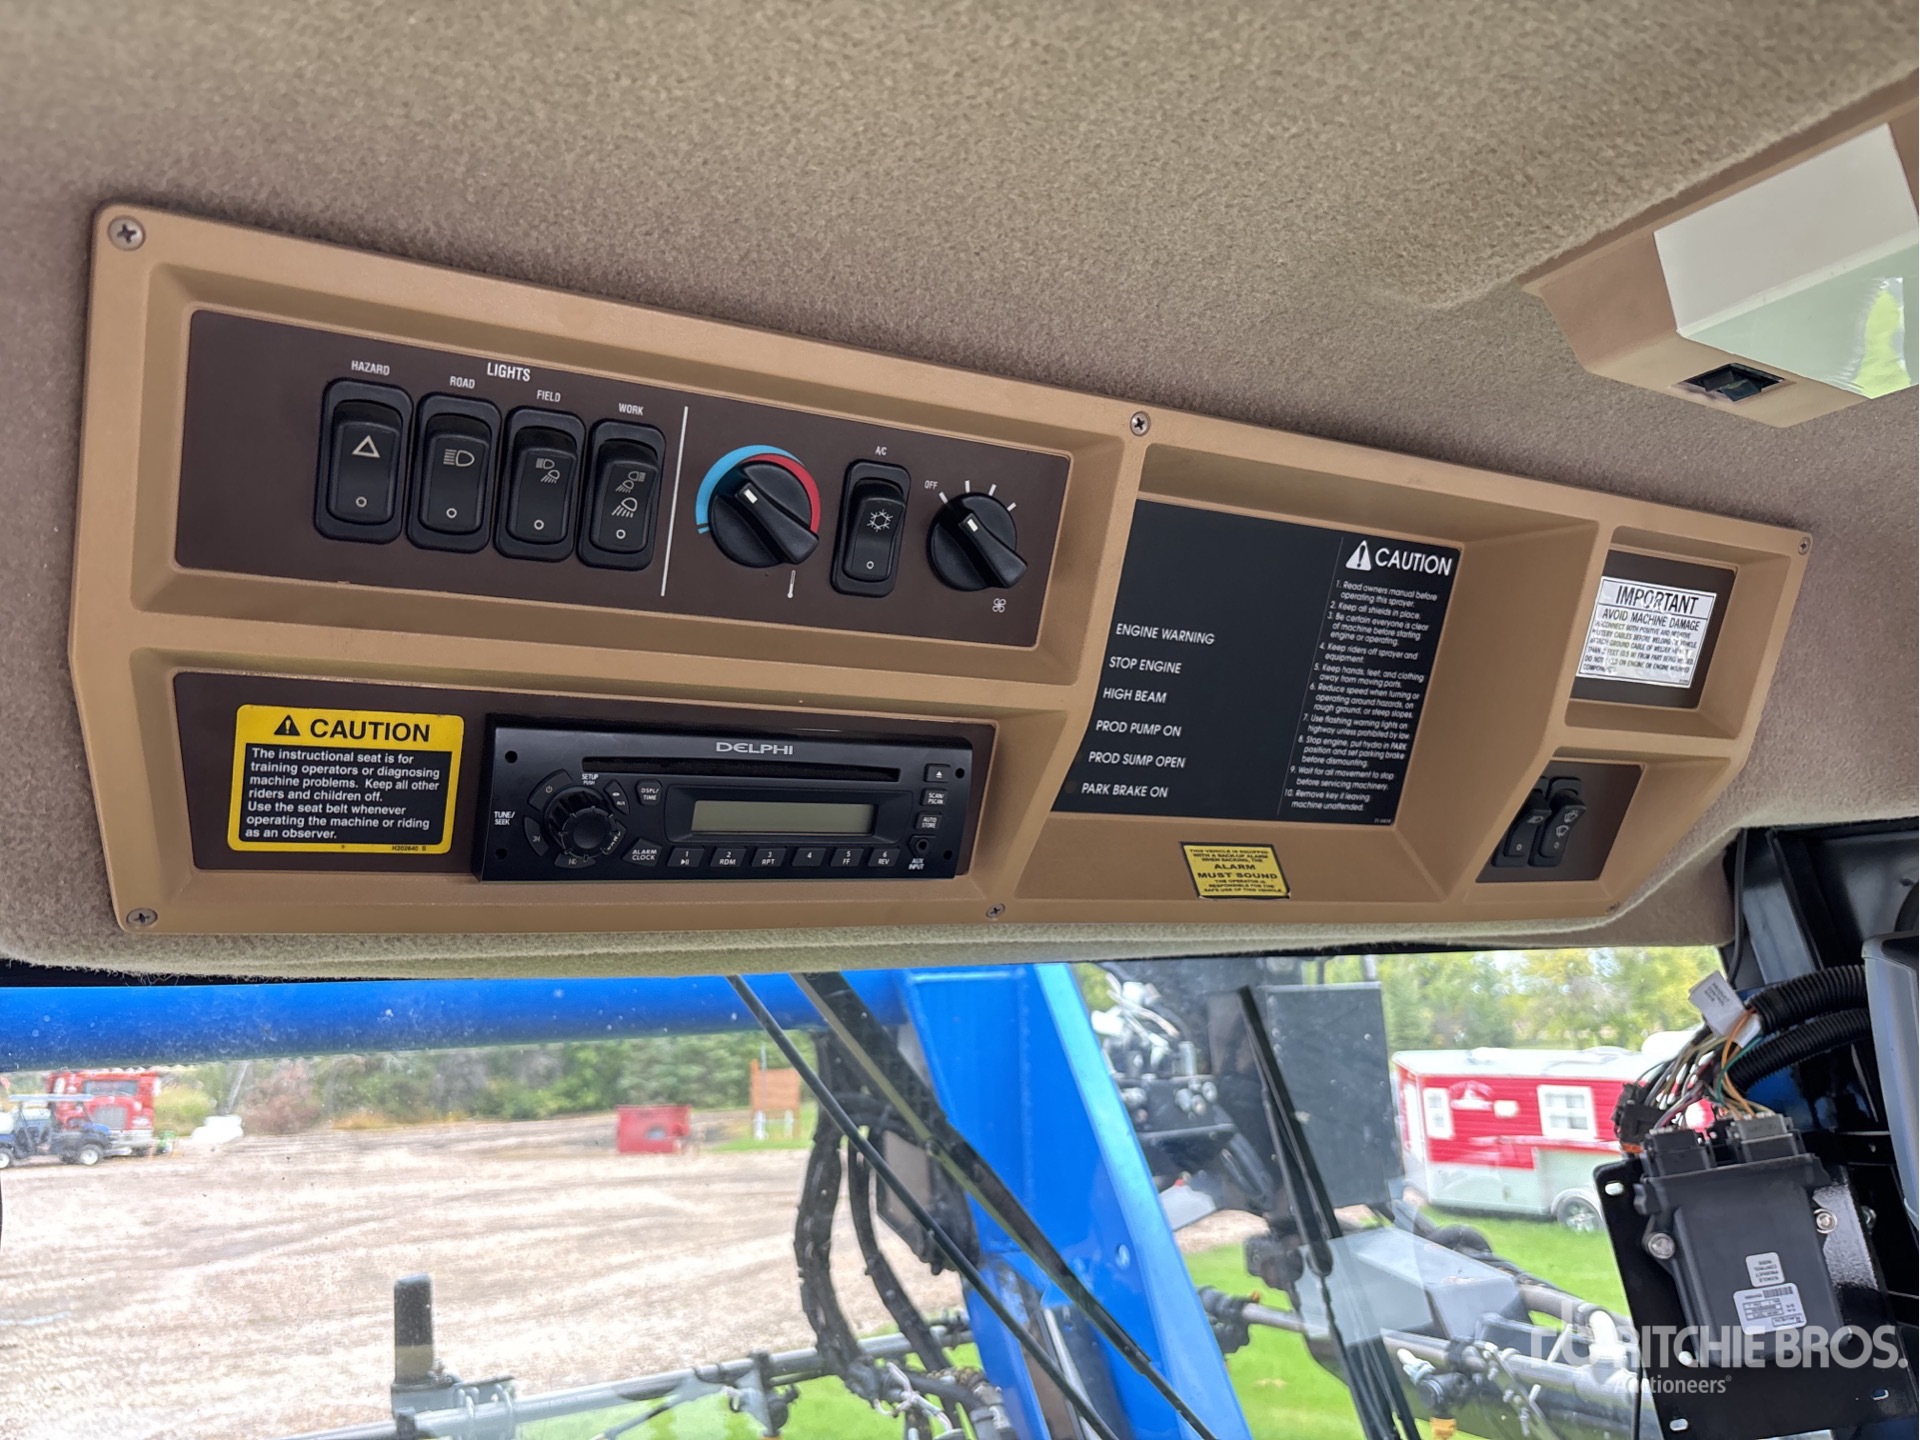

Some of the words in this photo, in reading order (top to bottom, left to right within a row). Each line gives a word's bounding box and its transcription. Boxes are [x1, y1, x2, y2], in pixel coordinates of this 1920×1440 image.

[351, 360, 390, 375] HAZARD
[487, 362, 530, 382] LIGHTS
[450, 376, 475, 389] ROAD
[537, 390, 561, 402] FIELD
[619, 403, 643, 415] WORK
[875, 446, 887, 456] A/C
[924, 480, 938, 489] OFF
[1375, 548, 1452, 576] CAUTION
[1340, 592, 1375, 604] operating
[1376, 596, 1388, 604] this
[1343, 580, 1362, 591] Read
[1363, 585, 1388, 593] owners
[1388, 589, 1415, 598] manual
[1415, 591, 1437, 601] before
[1616, 585, 1699, 614] IMPORTANT
[1338, 602, 1357, 612] Keep
[1368, 606, 1392, 616] shields
[1335, 612, 1345, 621] Be
[1346, 615, 1371, 624] certain
[1371, 618, 1404, 628] everyone
[1602, 608, 1628, 621] AVOID
[1630, 612, 1668, 627] MACHINE
[1669, 618, 1700, 631] DAMAGE
[1116, 623, 1159, 638] ENGINE
[1162, 628, 1214, 644] WARNING
[1330, 631, 1355, 641] engine
[1340, 624, 1372, 634] machine
[1373, 627, 1396, 636] before
[1396, 630, 1421, 641] starting
[1327, 643, 1346, 652] Keep
[1347, 646, 1367, 654] riders
[1378, 650, 1403, 658] sprayer
[1109, 656, 1138, 669] STOP
[1139, 659, 1182, 674] ENGINE
[1322, 664, 1341, 674] Keep
[1397, 672, 1424, 682] clothing
[1319, 674, 1340, 683] away
[1340, 675, 1357, 683] from
[1357, 678, 1384, 688] moving
[1103, 688, 1133, 700] HIGH
[1134, 690, 1167, 703] BEAM
[310, 718, 430, 742] CAUTION
[1096, 720, 1128, 732] PROD
[1130, 722, 1161, 735] PUMP
[1163, 725, 1182, 736] ON
[252, 747, 275, 759] The
[279, 749, 354, 762] instructional
[357, 753, 381, 763] seat
[385, 753, 394, 763] is
[398, 754, 414, 764] for
[716, 742, 793, 755] DELPHI
[1088, 751, 1120, 764] PROD
[1122, 753, 1153, 766] SUMP
[1155, 756, 1186, 768] OPEN
[251, 762, 298, 775] training
[301, 765, 358, 776] operators
[377, 766, 440, 780] diagnosing
[250, 775, 300, 786] machine
[302, 777, 358, 789] problems.
[365, 778, 393, 791] Keep
[395, 780, 408, 789] all
[411, 780, 439, 790] other
[1082, 783, 1110, 794] PARK
[1112, 784, 1148, 797] BRAKE
[1150, 786, 1168, 798] ON
[249, 788, 284, 799] riders
[288, 790, 310, 799] and
[314, 790, 361, 801] children
[364, 791, 382, 801] off.
[1295, 789, 1324, 798] Remove
[1325, 792, 1339, 800] key
[1345, 793, 1370, 802] leaving
[248, 801, 272, 811] Use
[275, 802, 294, 812] the
[298, 804, 322, 813] seat
[326, 803, 348, 813] belt
[351, 804, 406, 815] whenever
[246, 815, 305, 828] operating
[308, 816, 327, 826] the
[330, 817, 379, 827] machine
[397, 818, 430, 830] riding
[245, 829, 260, 837] as
[282, 828, 336, 838] observer.
